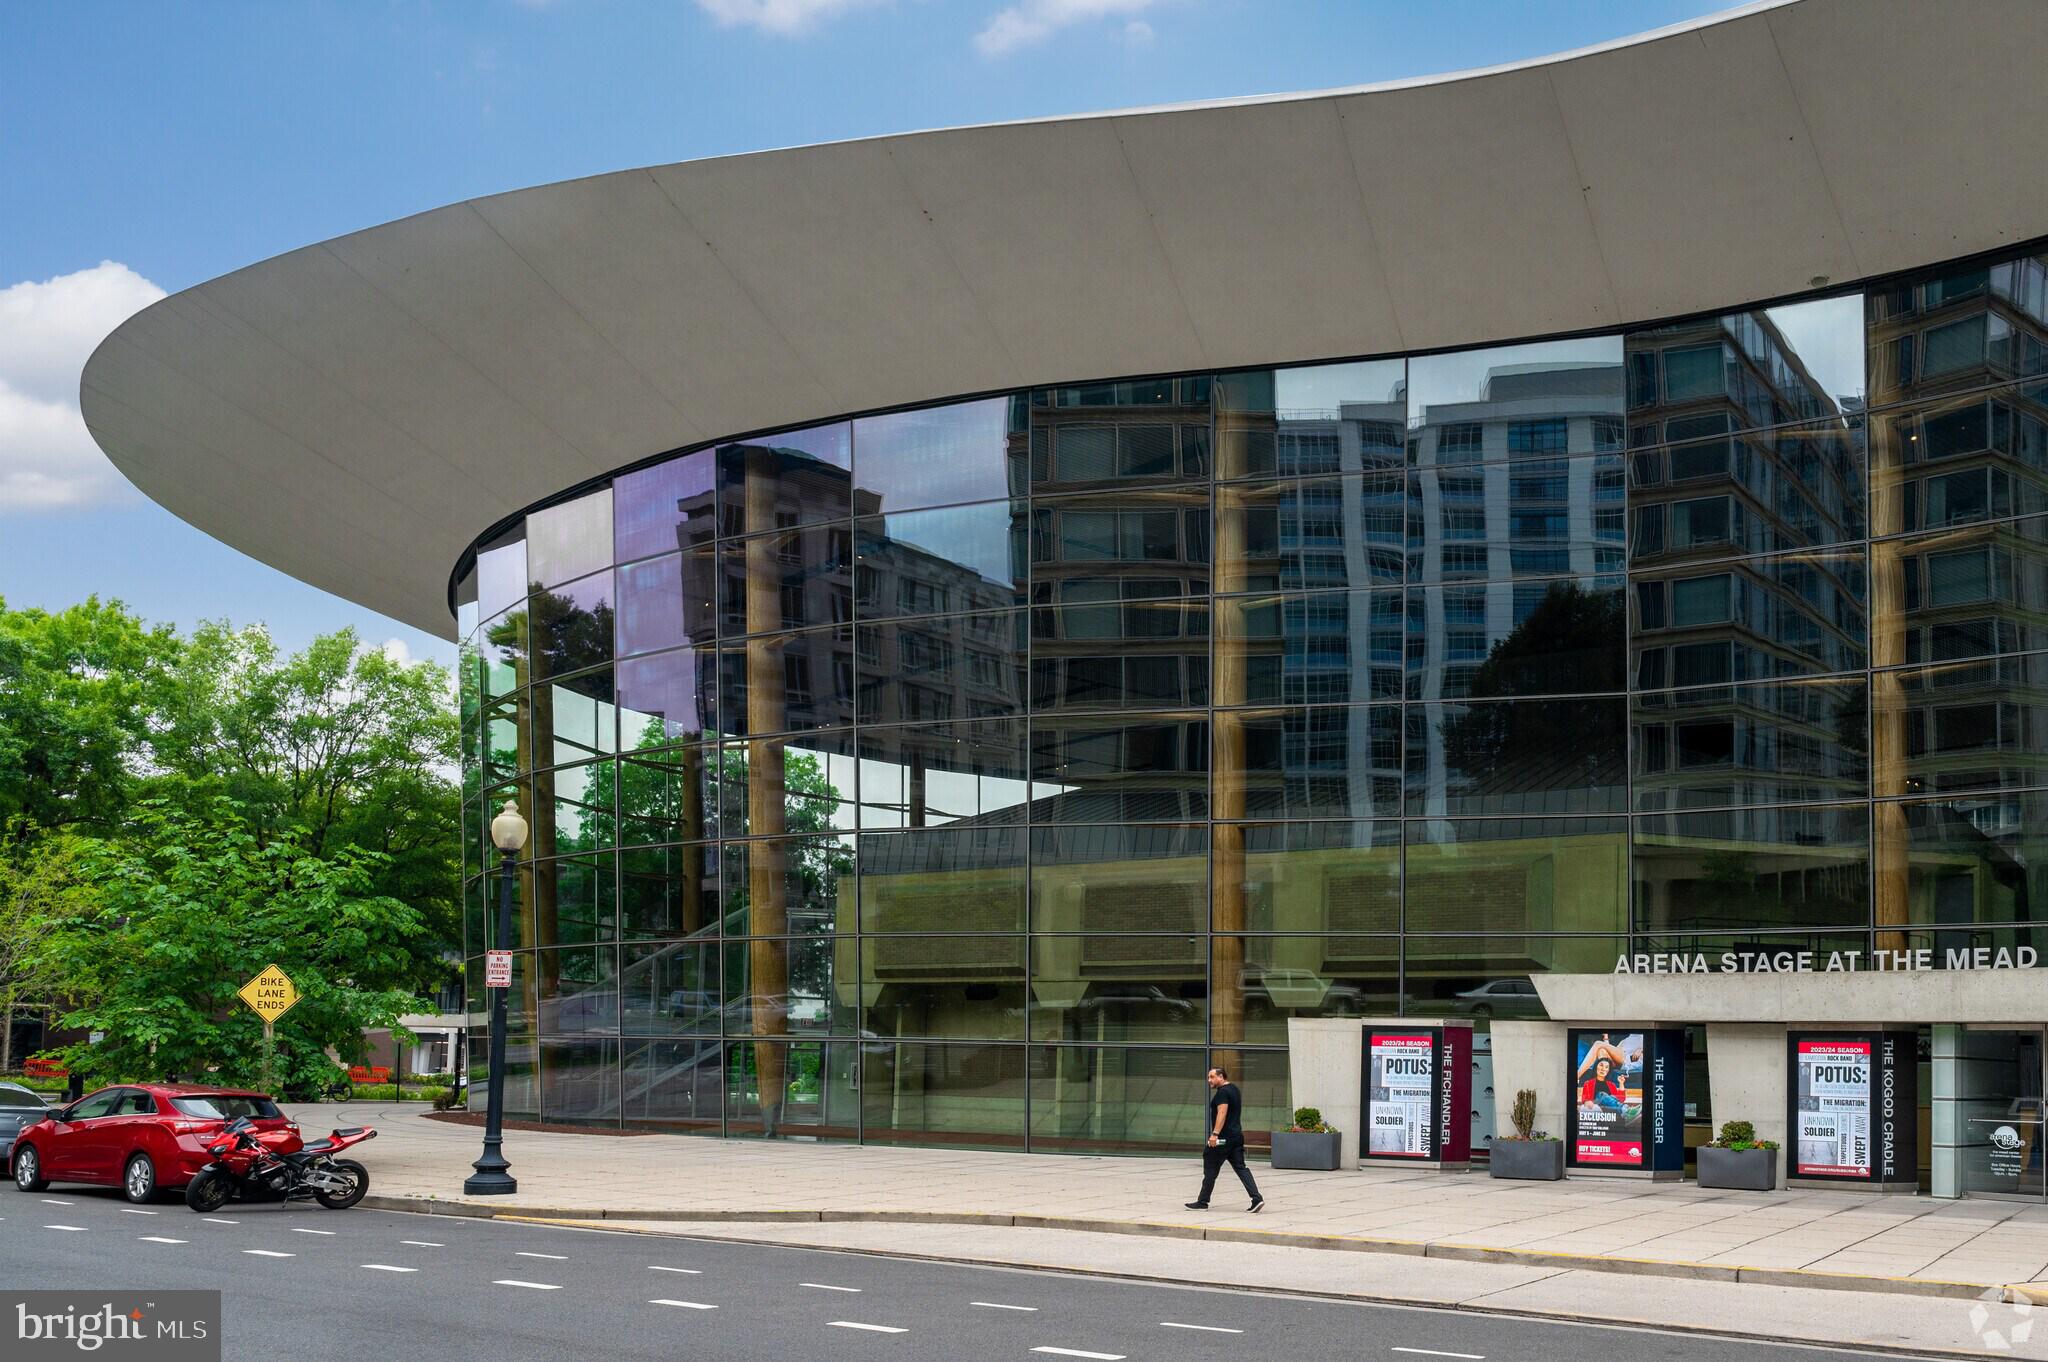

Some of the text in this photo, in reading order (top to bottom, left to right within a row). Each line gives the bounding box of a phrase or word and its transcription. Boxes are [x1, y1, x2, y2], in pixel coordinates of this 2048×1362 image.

[1614, 946, 2038, 974] ARENA STAGE AT THE MEAD
[260, 977, 284, 987] BIKE
[257, 989, 285, 998] LANE
[257, 1000, 285, 1010] ENDS
[1385, 1058, 1432, 1075] POTUS:
[1815, 1065, 1867, 1084] POTUS:
[1441, 1043, 1453, 1146] THE FICHANDLER
[1655, 1057, 1664, 1144] THE KREEGER
[1834, 1099, 1867, 1107] MIGRATION:
[1375, 1106, 1404, 1115] UNKNOWN
[1883, 1040, 1894, 1176] THE KOGOD CRADLE
[1375, 1116, 1404, 1125] SOLDIER
[1579, 1112, 1617, 1122] EXCLUSION
[1804, 1116, 1835, 1126] UNKNOWN
[1804, 1127, 1835, 1137] SOLDIER
[1989, 1133, 2013, 1141] arena
[1420, 1123, 1431, 1152] SWEPT
[2001, 1139, 2026, 1148] stage
[1854, 1135, 1866, 1165] SWEPT
